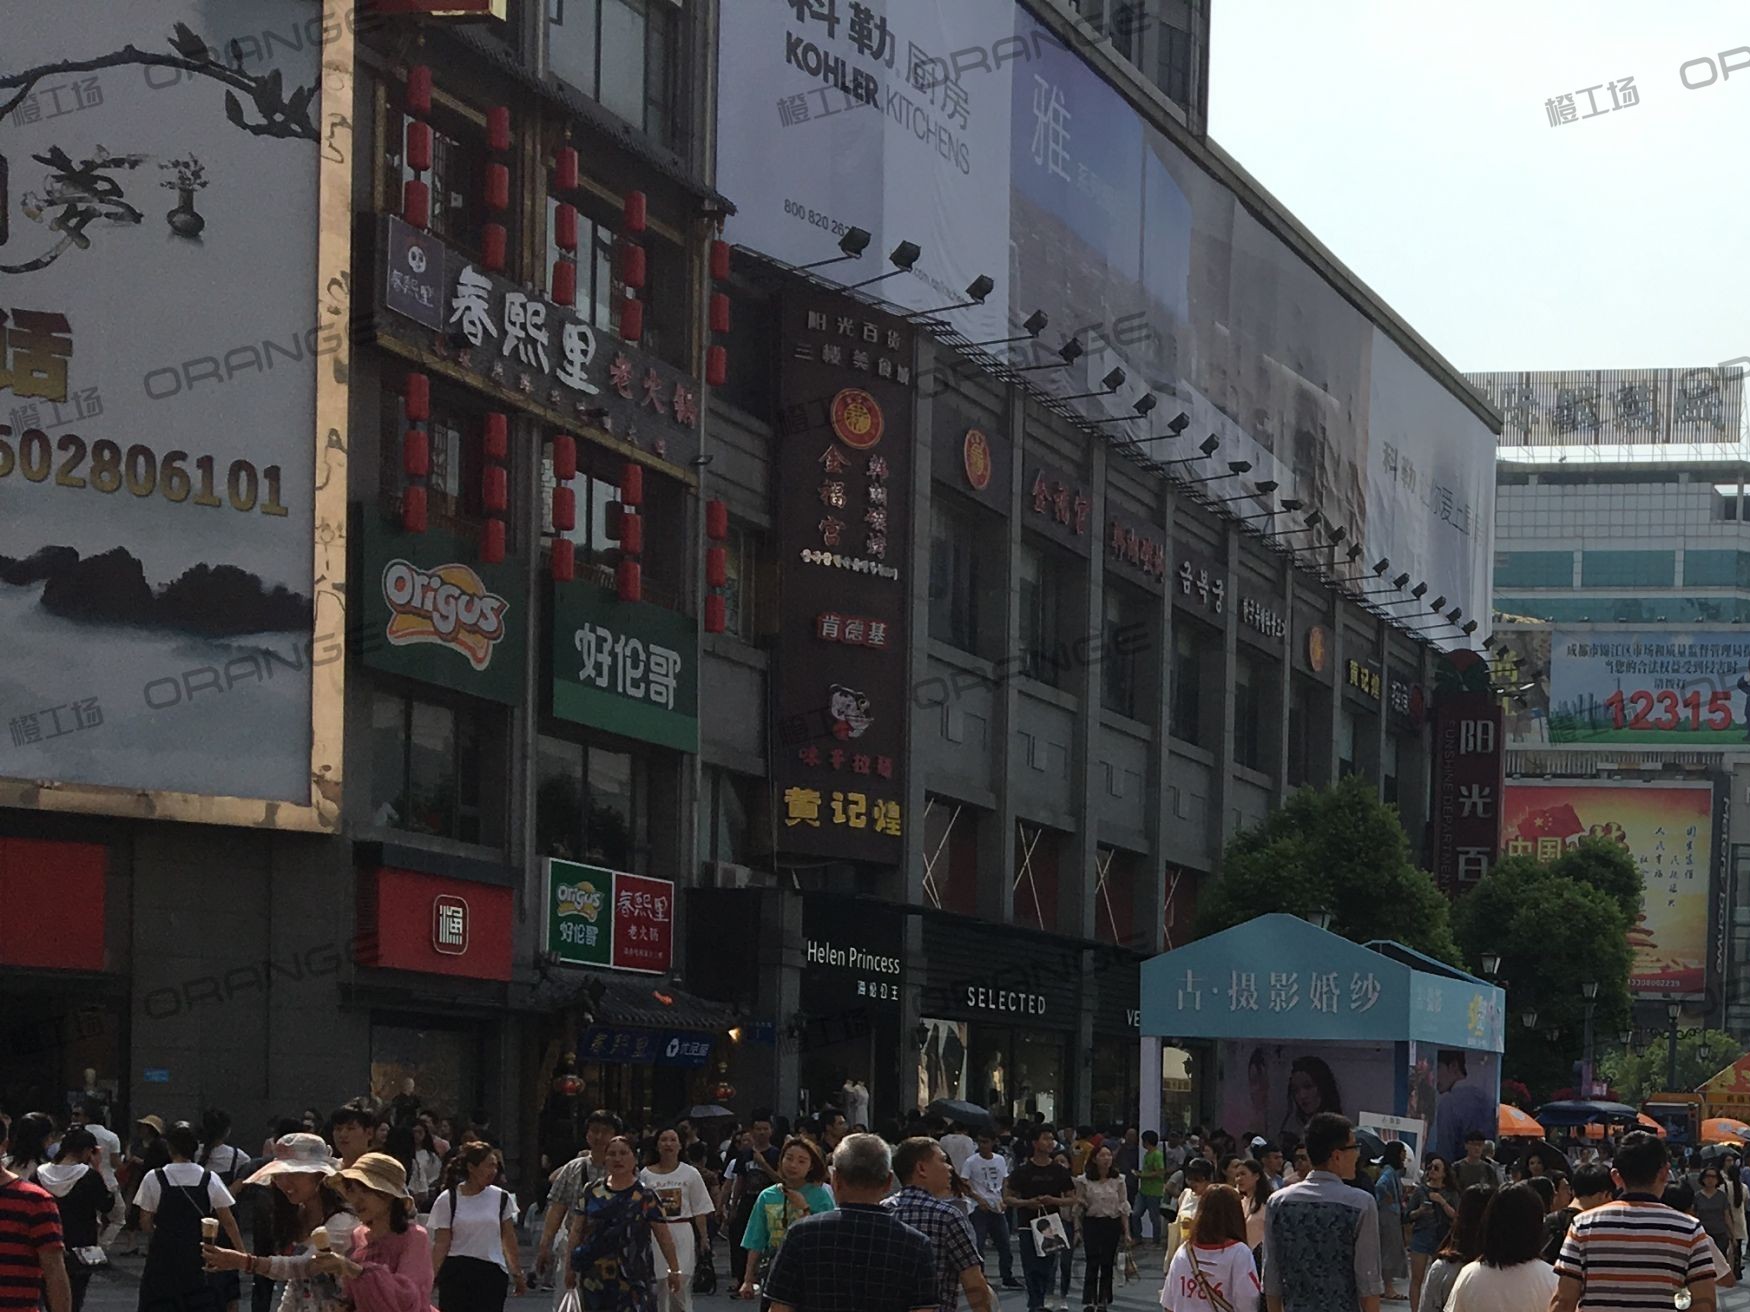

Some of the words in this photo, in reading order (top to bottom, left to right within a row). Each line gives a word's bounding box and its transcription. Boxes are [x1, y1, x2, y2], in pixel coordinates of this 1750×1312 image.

[785, 30, 882, 112] KOHLER
[885, 83, 971, 176] KITCHENS
[1031, 73, 1072, 182] 雅
[784, 199, 805, 221] 800
[808, 211, 829, 231] 820
[449, 265, 600, 394] 春熙里
[609, 351, 698, 430] 老火锅
[807, 310, 900, 351] 阳光百货
[818, 443, 851, 547] 金福宫
[383, 560, 506, 640] Origus
[822, 614, 887, 645] 肯德基
[574, 622, 681, 711] 好伦哥
[1605, 689, 1733, 731] 12315
[784, 785, 902, 836] 黄记煌
[560, 920, 599, 947] 好伦哥
[807, 939, 847, 967] Helen
[848, 946, 901, 975] Princess
[966, 986, 1047, 1015] SELECTED
